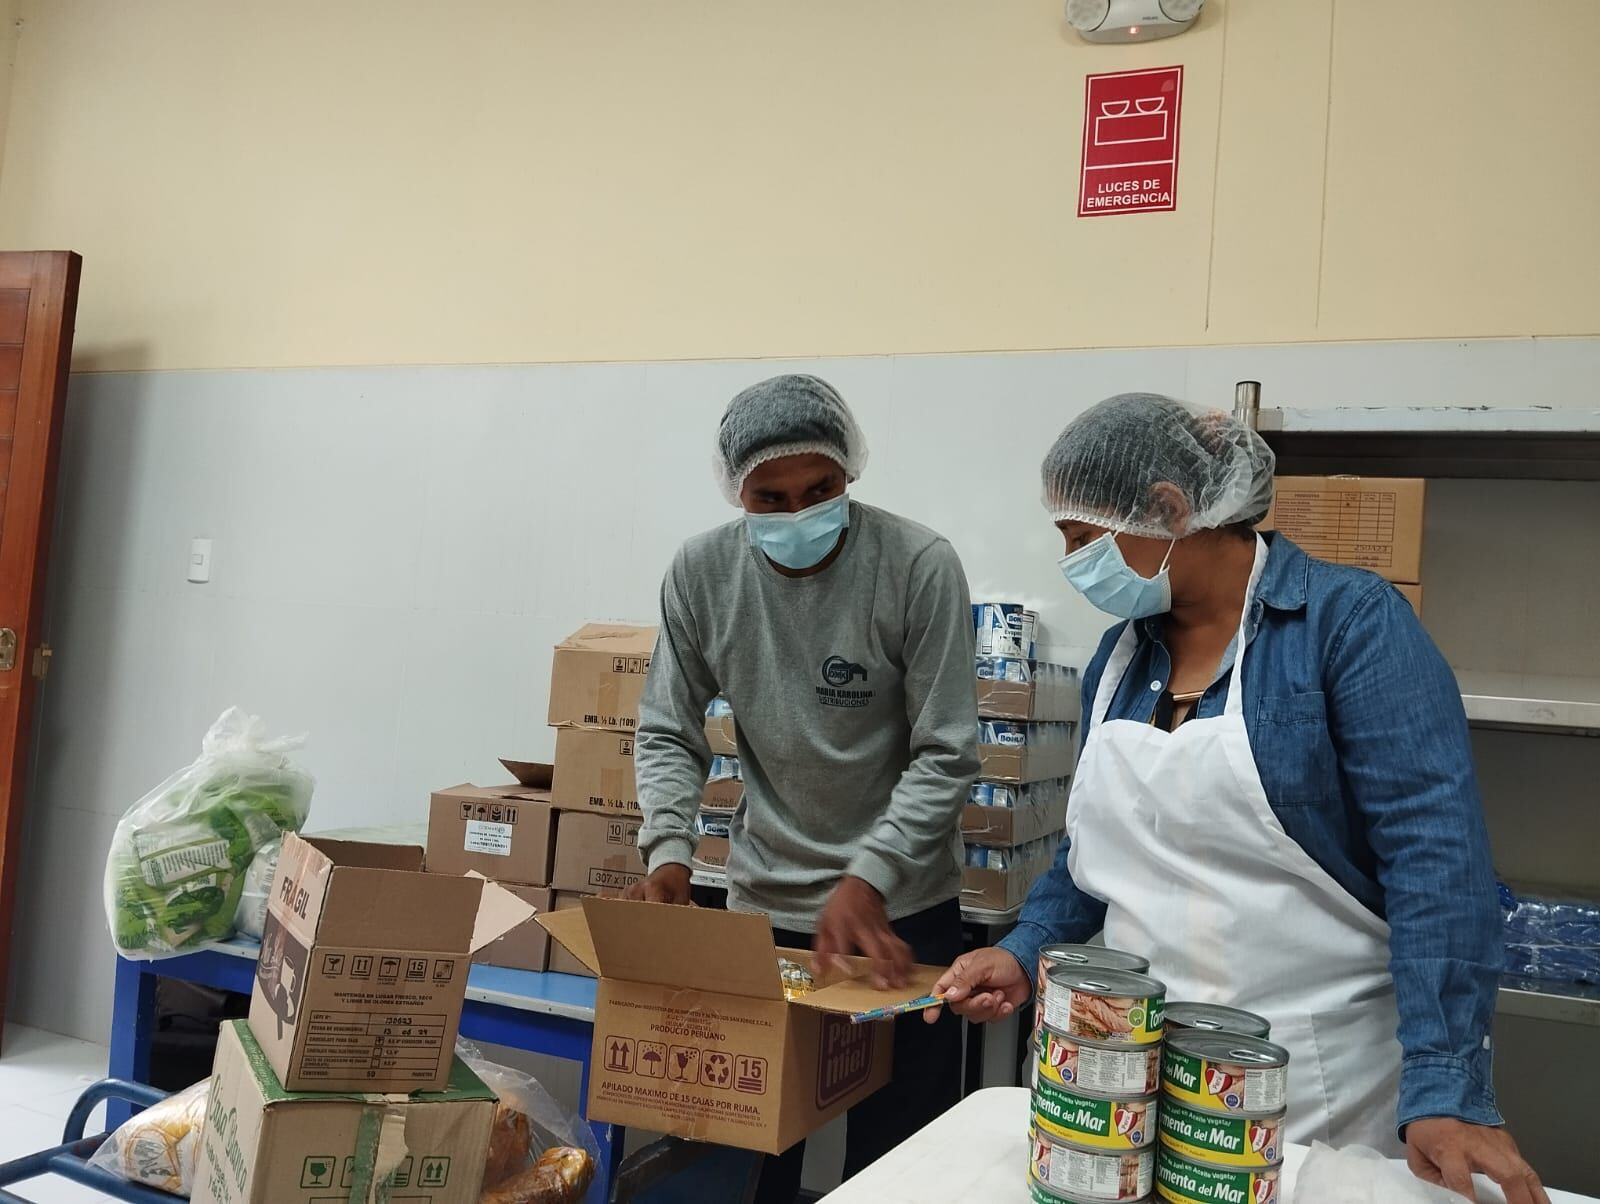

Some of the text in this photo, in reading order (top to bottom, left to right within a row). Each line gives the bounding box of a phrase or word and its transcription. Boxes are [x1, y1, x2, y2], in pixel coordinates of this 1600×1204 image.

[1098, 179, 1161, 194] LUCES DE
[1087, 192, 1170, 208] EMERGENCIA
[584, 714, 600, 724] EMB.
[608, 716, 618, 726] Lb.
[619, 717, 636, 728] (109)
[589, 797, 605, 807] EMB.
[615, 799, 625, 809] Lb.
[610, 824, 621, 836] 10
[595, 872, 612, 884] 307
[412, 961, 424, 971] 15
[650, 1024, 690, 1036] PRODUCTO
[690, 1028, 726, 1042] PERUANO
[740, 1059, 762, 1079] 15
[1173, 1063, 1197, 1088] Mar
[602, 1081, 760, 1115] APILADO MAXIMO DE 15 CAJAS POR RUMA.
[1062, 1110, 1075, 1123] del
[1075, 1108, 1106, 1132] Mar
[1194, 1128, 1208, 1142] del
[1209, 1127, 1241, 1150] Mar
[1198, 1184, 1213, 1197] del
[1214, 1182, 1245, 1204] Mar
